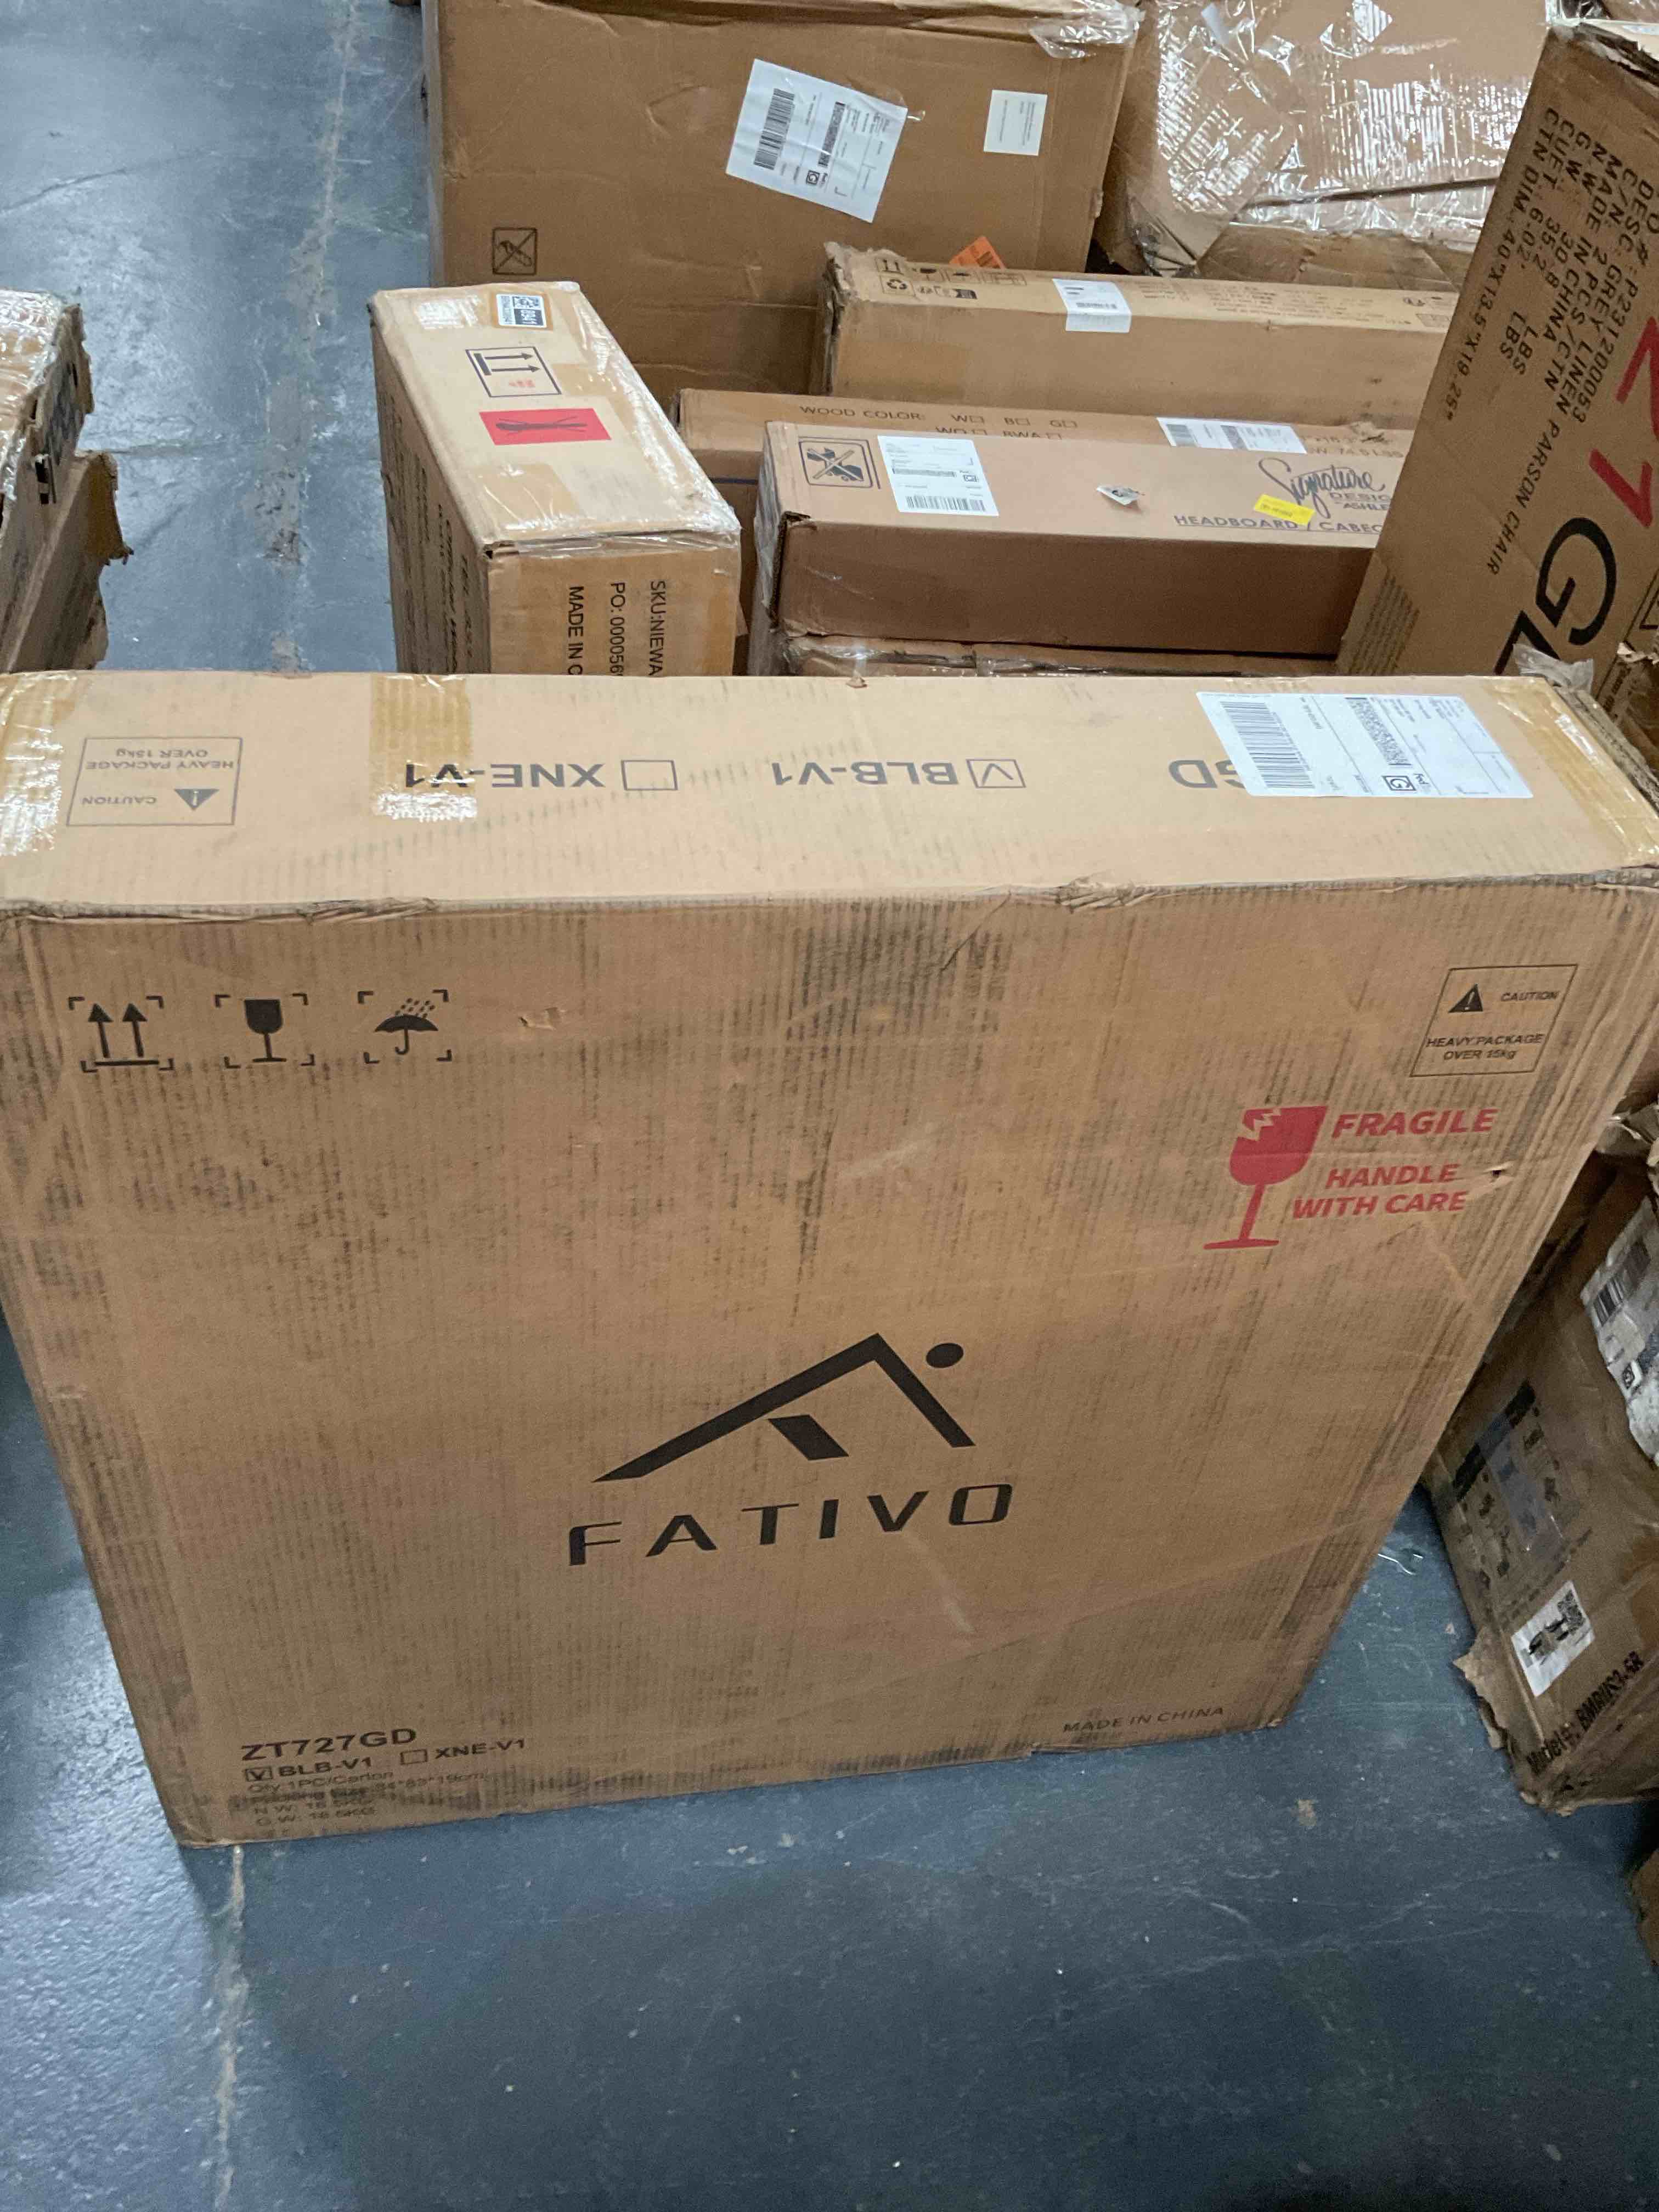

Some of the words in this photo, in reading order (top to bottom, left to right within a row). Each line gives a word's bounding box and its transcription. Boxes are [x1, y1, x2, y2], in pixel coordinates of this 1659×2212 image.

[1530, 105, 1560, 163] CTN
[1583, 153, 1624, 233] MADE
[1572, 234, 1593, 265] IN
[1591, 246, 1608, 266] 2
[1542, 267, 1581, 344] CHINA
[1586, 261, 1624, 332] GREY
[1498, 309, 1527, 362] LBS
[1542, 269, 1600, 393] PCS/CTN
[1511, 324, 1540, 376] LBS
[1554, 338, 1594, 416] LINEN
[800, 405, 855, 417] WOOD
[1513, 416, 1561, 511] PARSON
[1259, 457, 1385, 519] Signature
[1174, 515, 1298, 530] HEADBOARD
[1485, 508, 1522, 577] CHAIR
[568, 586, 584, 637] MADE
[611, 582, 625, 612] PO:
[568, 642, 583, 659] IN
[610, 617, 625, 676] 000056
[85, 761, 171, 770] PACKAGE
[116, 748, 152, 758] 15kg
[159, 749, 207, 758] OVER
[175, 760, 234, 769] HEAVY
[405, 764, 606, 788] XNE-V1
[772, 761, 957, 786] BLB-V1
[1501, 991, 1559, 1002] CAUTION
[1426, 1035, 1473, 1047] HEAVY
[1476, 1033, 1545, 1046] PACKAGE
[1443, 1048, 1484, 1060] OVER
[1486, 1048, 1516, 1060] 15kg
[1330, 1109, 1498, 1139] FRAGILE
[1325, 1165, 1460, 1189] HANDLE
[1293, 1194, 1379, 1219] WITH
[1385, 1191, 1468, 1214] CARE
[569, 1483, 1013, 1566] FATIVO
[1063, 1717, 1125, 1732] MADE
[1129, 1713, 1152, 1725] IN
[1158, 1707, 1224, 1722] CHINA
[241, 1728, 417, 1762] ZT727GD
[278, 1757, 373, 1778] BLB-V1
[434, 1738, 526, 1760] XNE-V1
